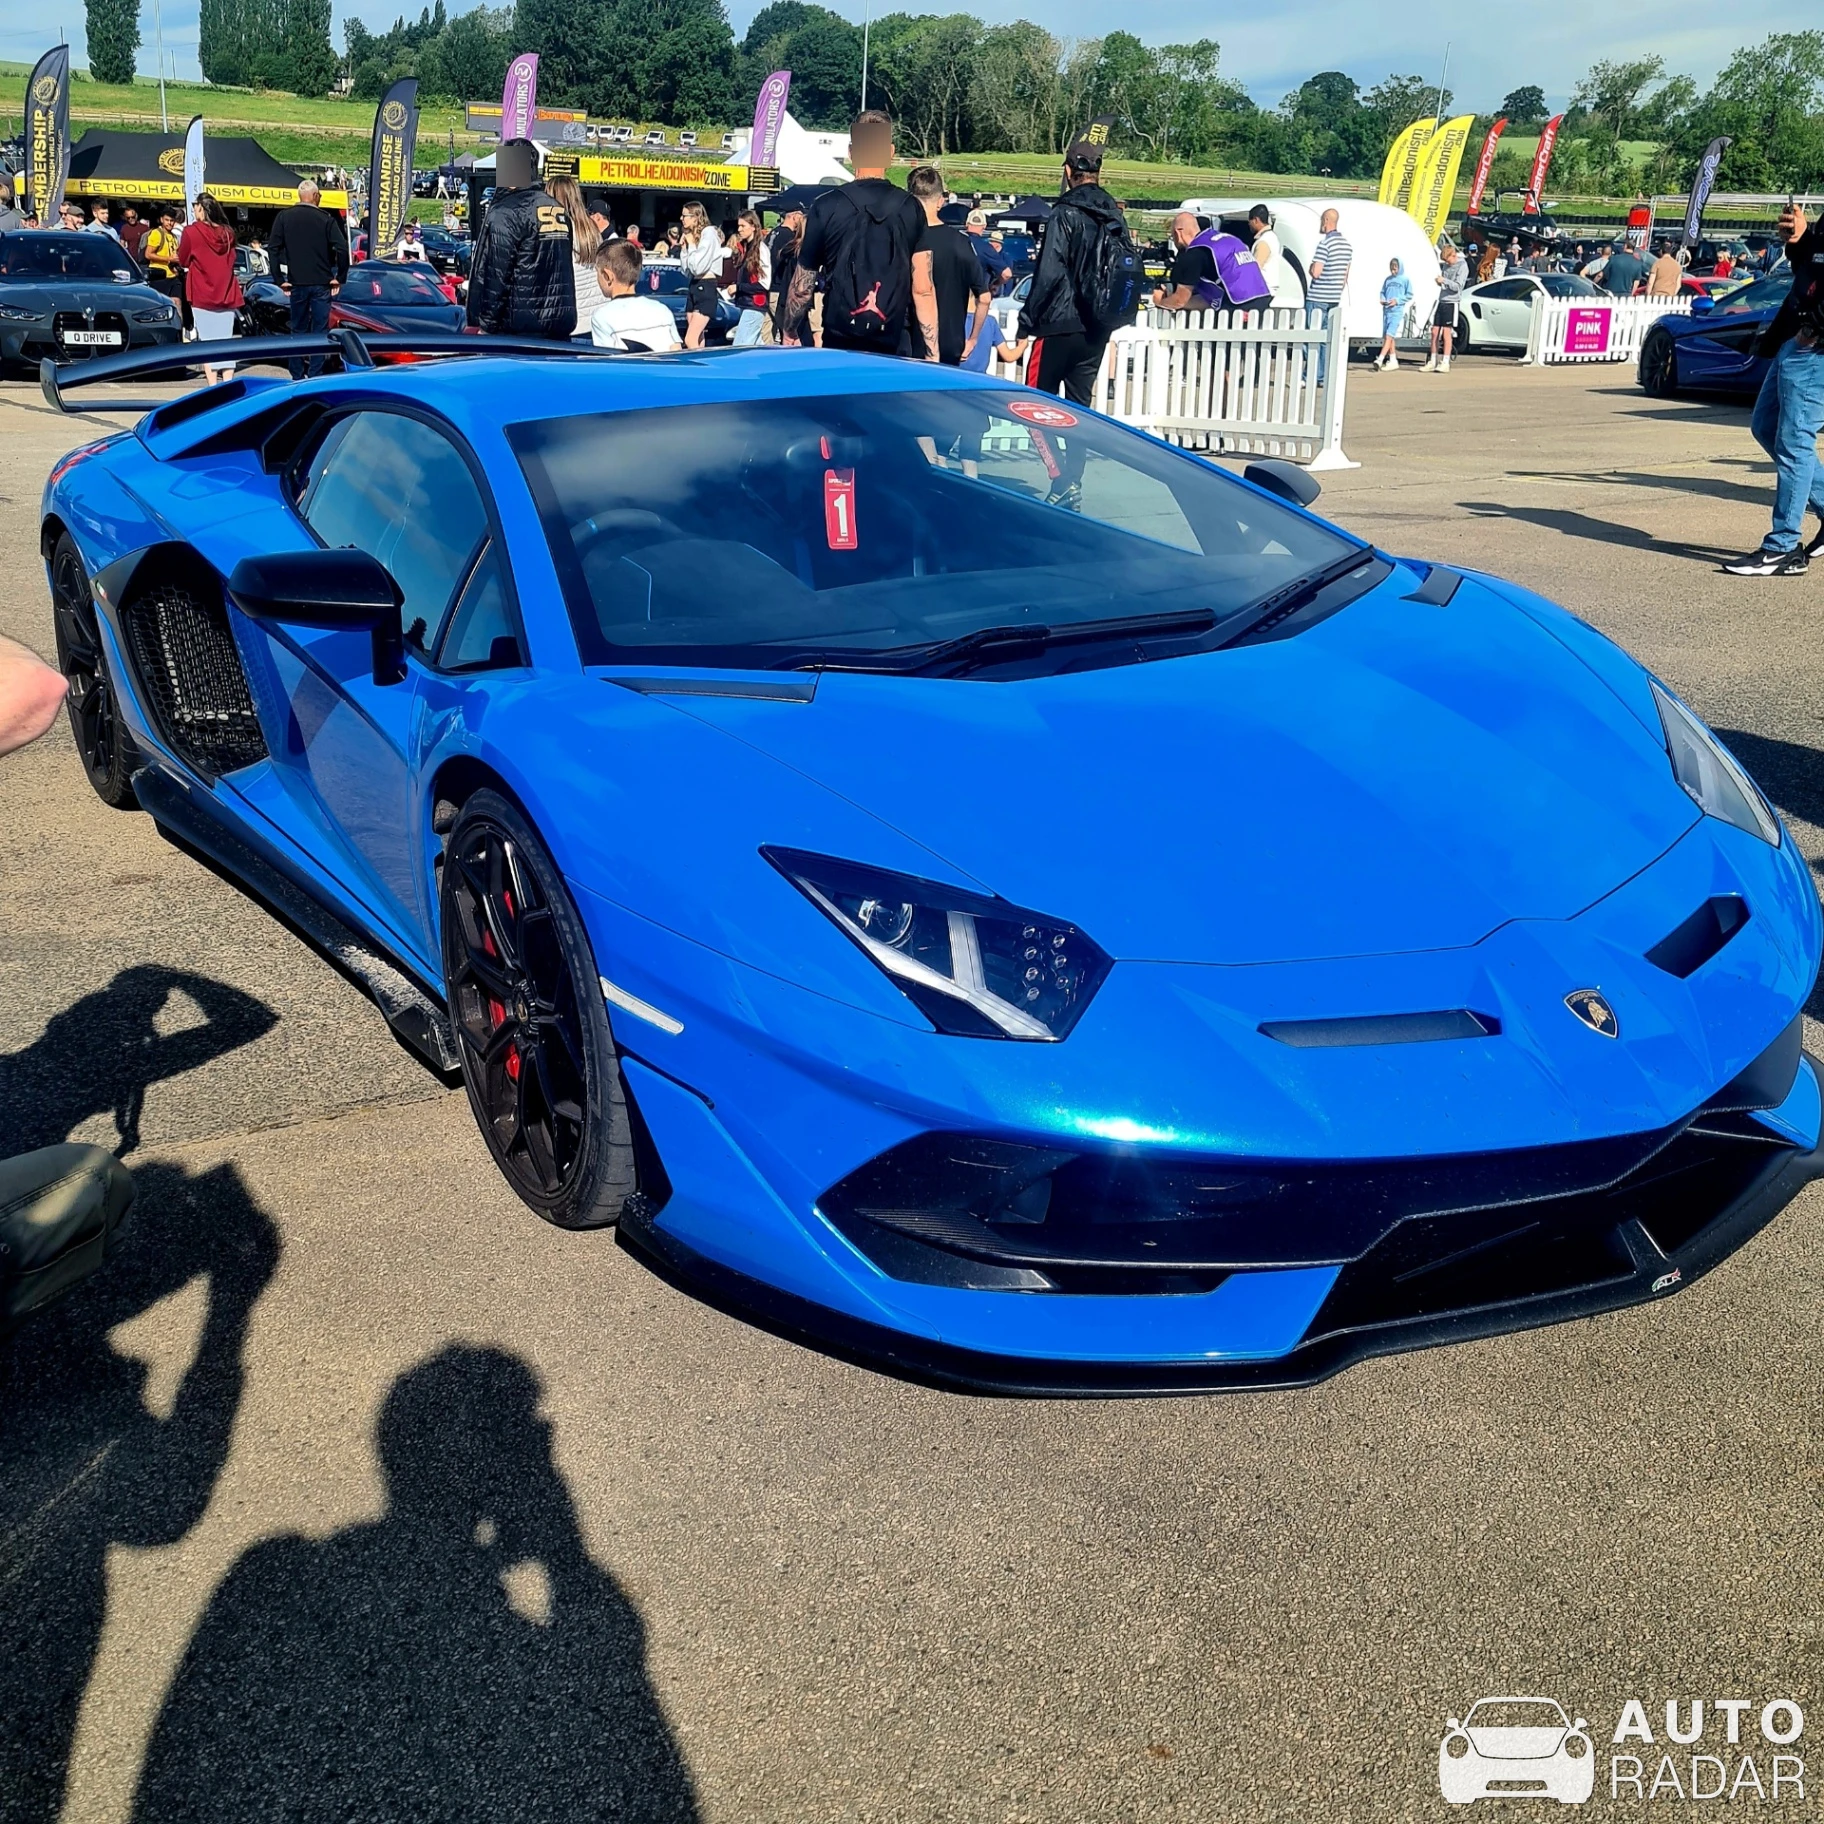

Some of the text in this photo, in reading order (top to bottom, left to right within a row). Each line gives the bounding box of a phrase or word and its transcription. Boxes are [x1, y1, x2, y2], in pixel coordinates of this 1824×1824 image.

[515, 83, 528, 138] IMULATORS
[394, 136, 403, 175] ONLINE
[1470, 131, 1499, 210] MasterCraft
[80, 180, 293, 200] PETROLHEANISM CLUB
[378, 133, 393, 244] MERCHANDISE
[74, 333, 112, 343] Q DRIVE
[1575, 322, 1602, 335] PINK
[833, 493, 849, 537] 1
